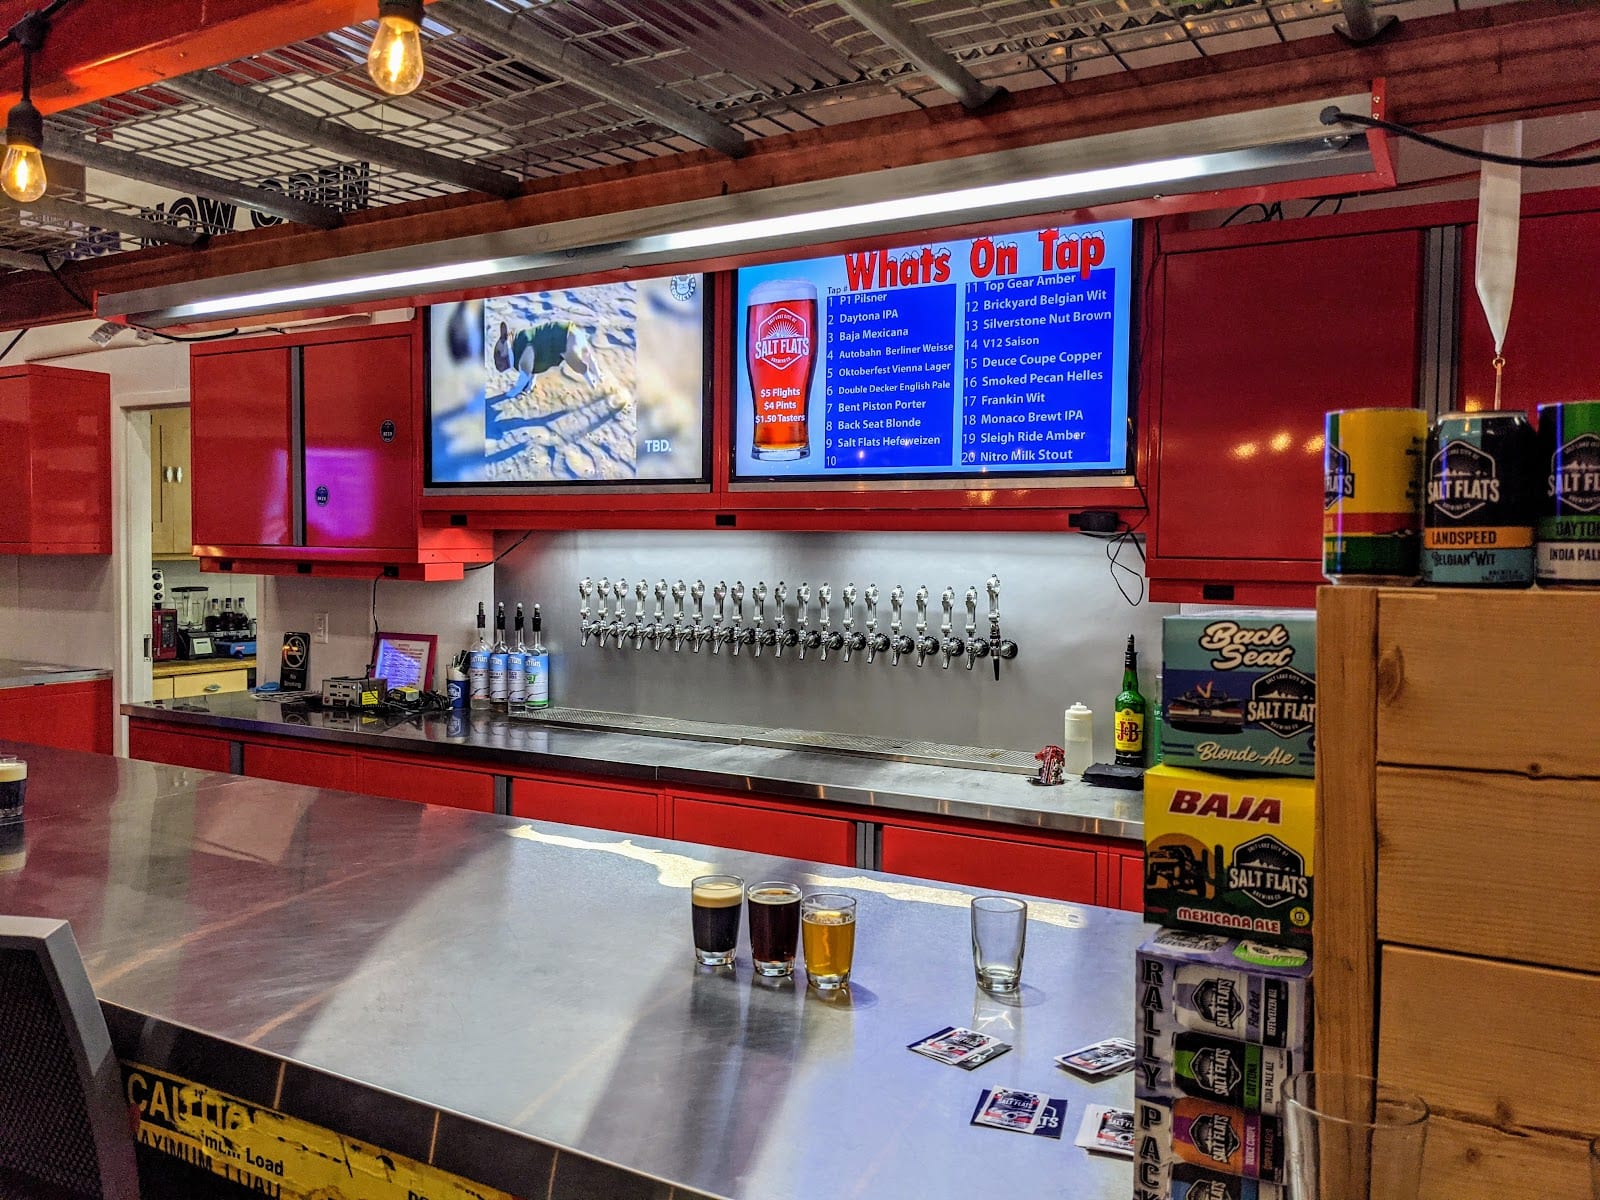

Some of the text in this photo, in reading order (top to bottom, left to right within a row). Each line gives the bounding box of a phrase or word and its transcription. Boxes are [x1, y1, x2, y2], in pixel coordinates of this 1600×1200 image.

[845, 227, 1105, 291] Whats On Tap
[828, 286, 841, 295] Tap
[966, 273, 1076, 294] 11 Top Gear Amber
[840, 296, 850, 305] P1
[854, 293, 888, 304] Pilsner
[965, 289, 1107, 313] 12 Brickyard Belgian Wit
[828, 309, 899, 325] 2 Daytona IPA
[965, 309, 1111, 332] 13 Silverstone Nut Brown
[828, 328, 909, 343] 3 Baja Mexicana
[965, 337, 1040, 350] 14 V12 Saison
[755, 337, 809, 359] SALT FLATS
[827, 343, 954, 360] 4 Autobahn Berliner Weisse
[965, 351, 1103, 369] 15 Deuce Coupe Copper
[827, 362, 951, 378] 5 Oktoberfest Vienna Lager
[964, 369, 1103, 388] 16 Smoked Pecan Helles
[760, 387, 800, 398] $5 Flights
[826, 381, 951, 395] 6 Double Decker English Pale
[763, 401, 797, 410] $4 Pints
[827, 400, 927, 414] 7 Bent Piston Porter
[963, 392, 1045, 406] 17 Frankin Wit
[755, 414, 806, 424] $1.50 Tasters
[826, 417, 921, 431] 8 Back Seat Blonde
[963, 410, 1084, 425] 18 Monaco Brewt IPA
[826, 435, 940, 448] 9 Salt Flats Hefeweizen
[963, 429, 1086, 445] 19 Sleigh Ride Amber
[645, 440, 672, 452] TBD.
[826, 455, 837, 466] 10
[961, 449, 1073, 463] 20 Nitro Milk Stout
[1427, 478, 1500, 504] SALT FLATS
[1547, 473, 1581, 497] SALT
[1431, 530, 1497, 545] LANDSPEED
[1549, 548, 1575, 560] INDIA
[1198, 620, 1290, 651] Back
[1210, 643, 1296, 671] Seat
[1247, 701, 1282, 721] SALT
[1197, 741, 1295, 766] Blonde Ale
[1168, 788, 1282, 825] BAJA
[1229, 868, 1308, 898] SALT FLATS
[1177, 906, 1280, 934] MEXICANA ALE
[1216, 979, 1233, 1028] SALT FLATS
[1142, 959, 1164, 1090] RALLY
[1214, 1048, 1231, 1096] SALT FLATS
[1212, 1115, 1229, 1163] SALT FLATS
[246, 1147, 285, 1178] Load
